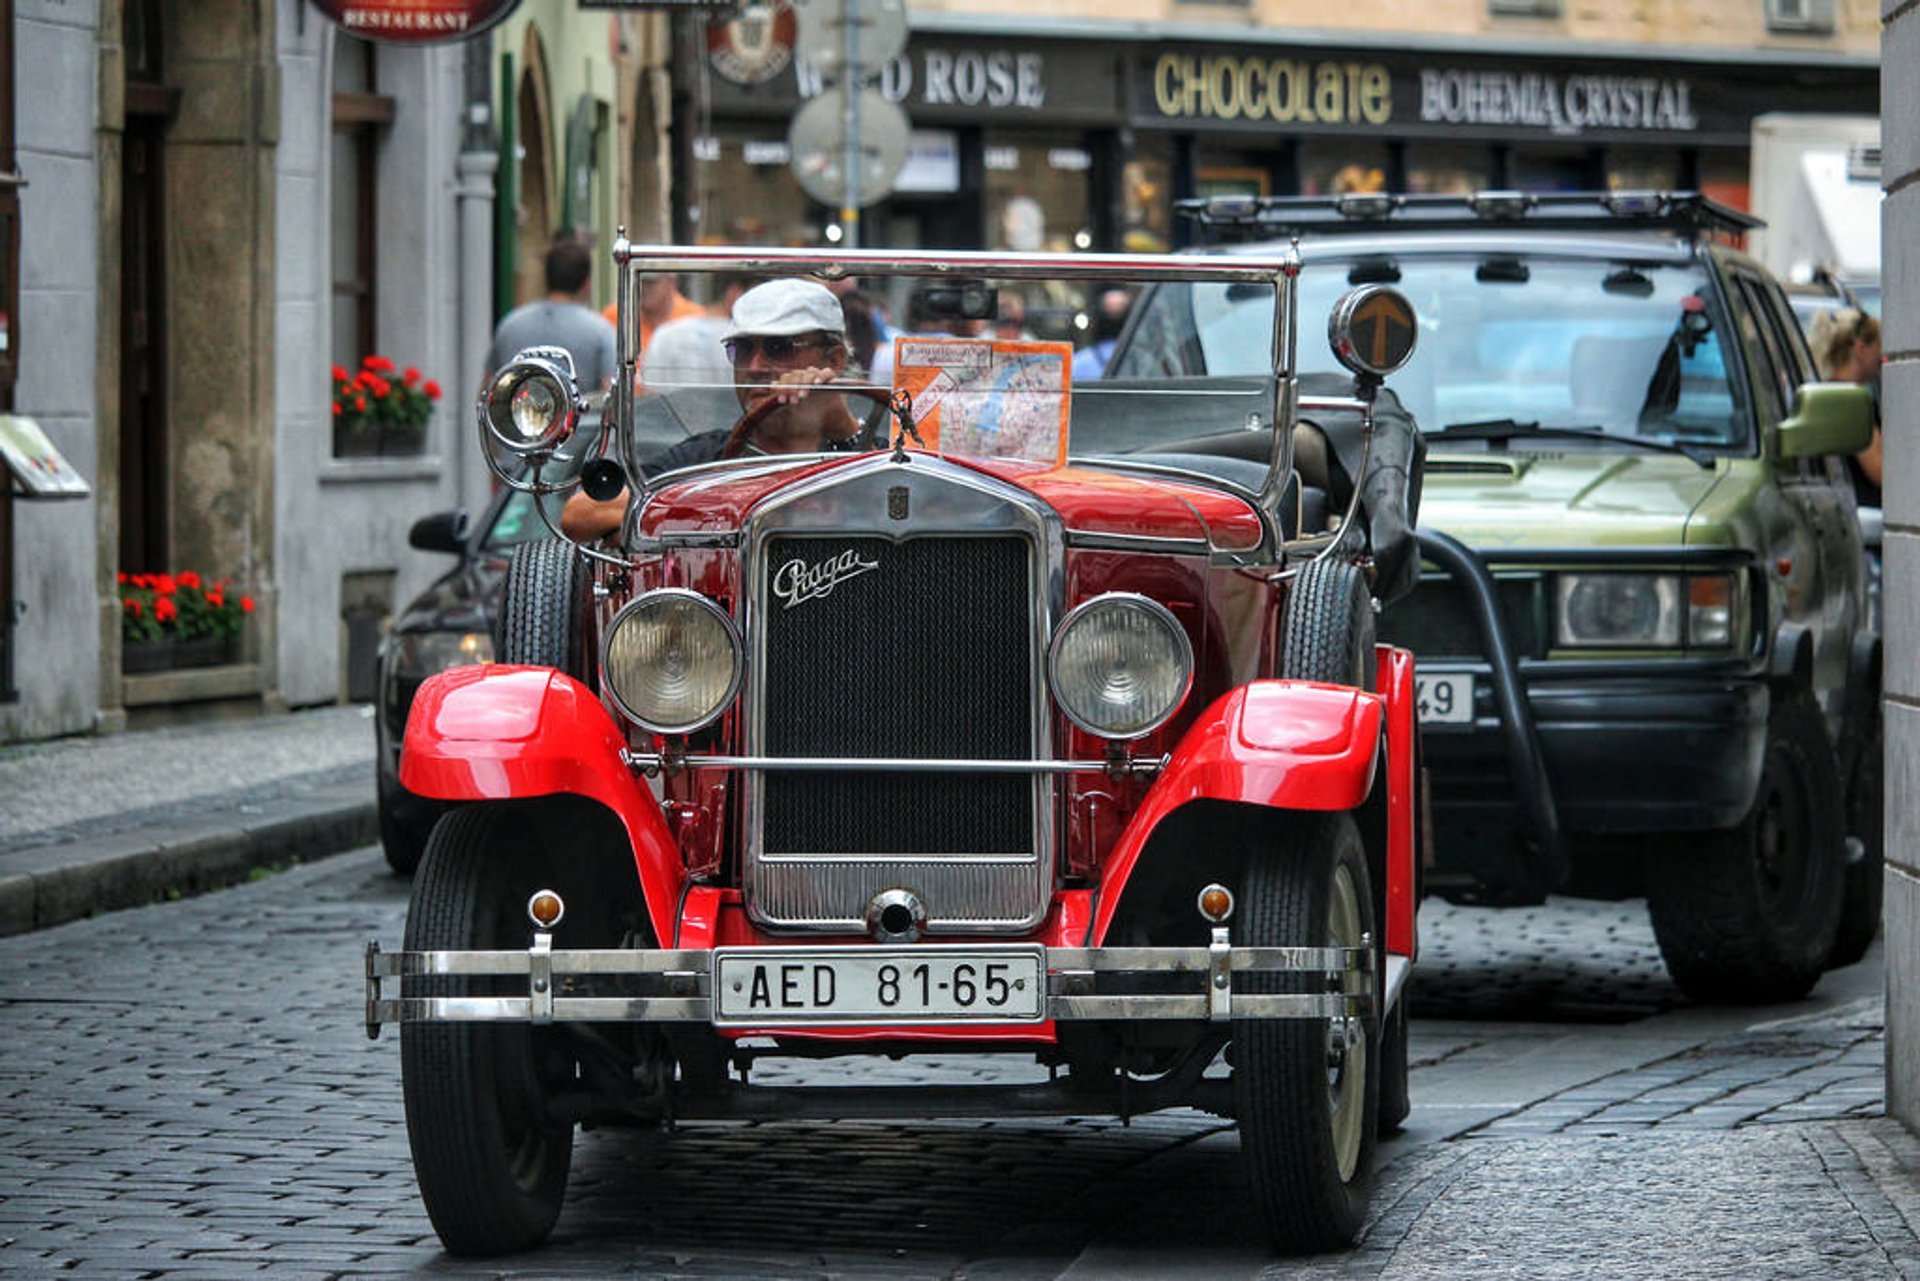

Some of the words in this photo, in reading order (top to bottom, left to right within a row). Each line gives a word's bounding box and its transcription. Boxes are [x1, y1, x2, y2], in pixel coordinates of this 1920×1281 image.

[343, 10, 469, 30] RESTAURANT
[923, 52, 1043, 107] ROSE
[1420, 70, 1565, 126] BOHEMIA
[1564, 75, 1696, 130] CRYSTAL
[749, 965, 836, 1008] AED
[877, 963, 1010, 1007] 81-65
